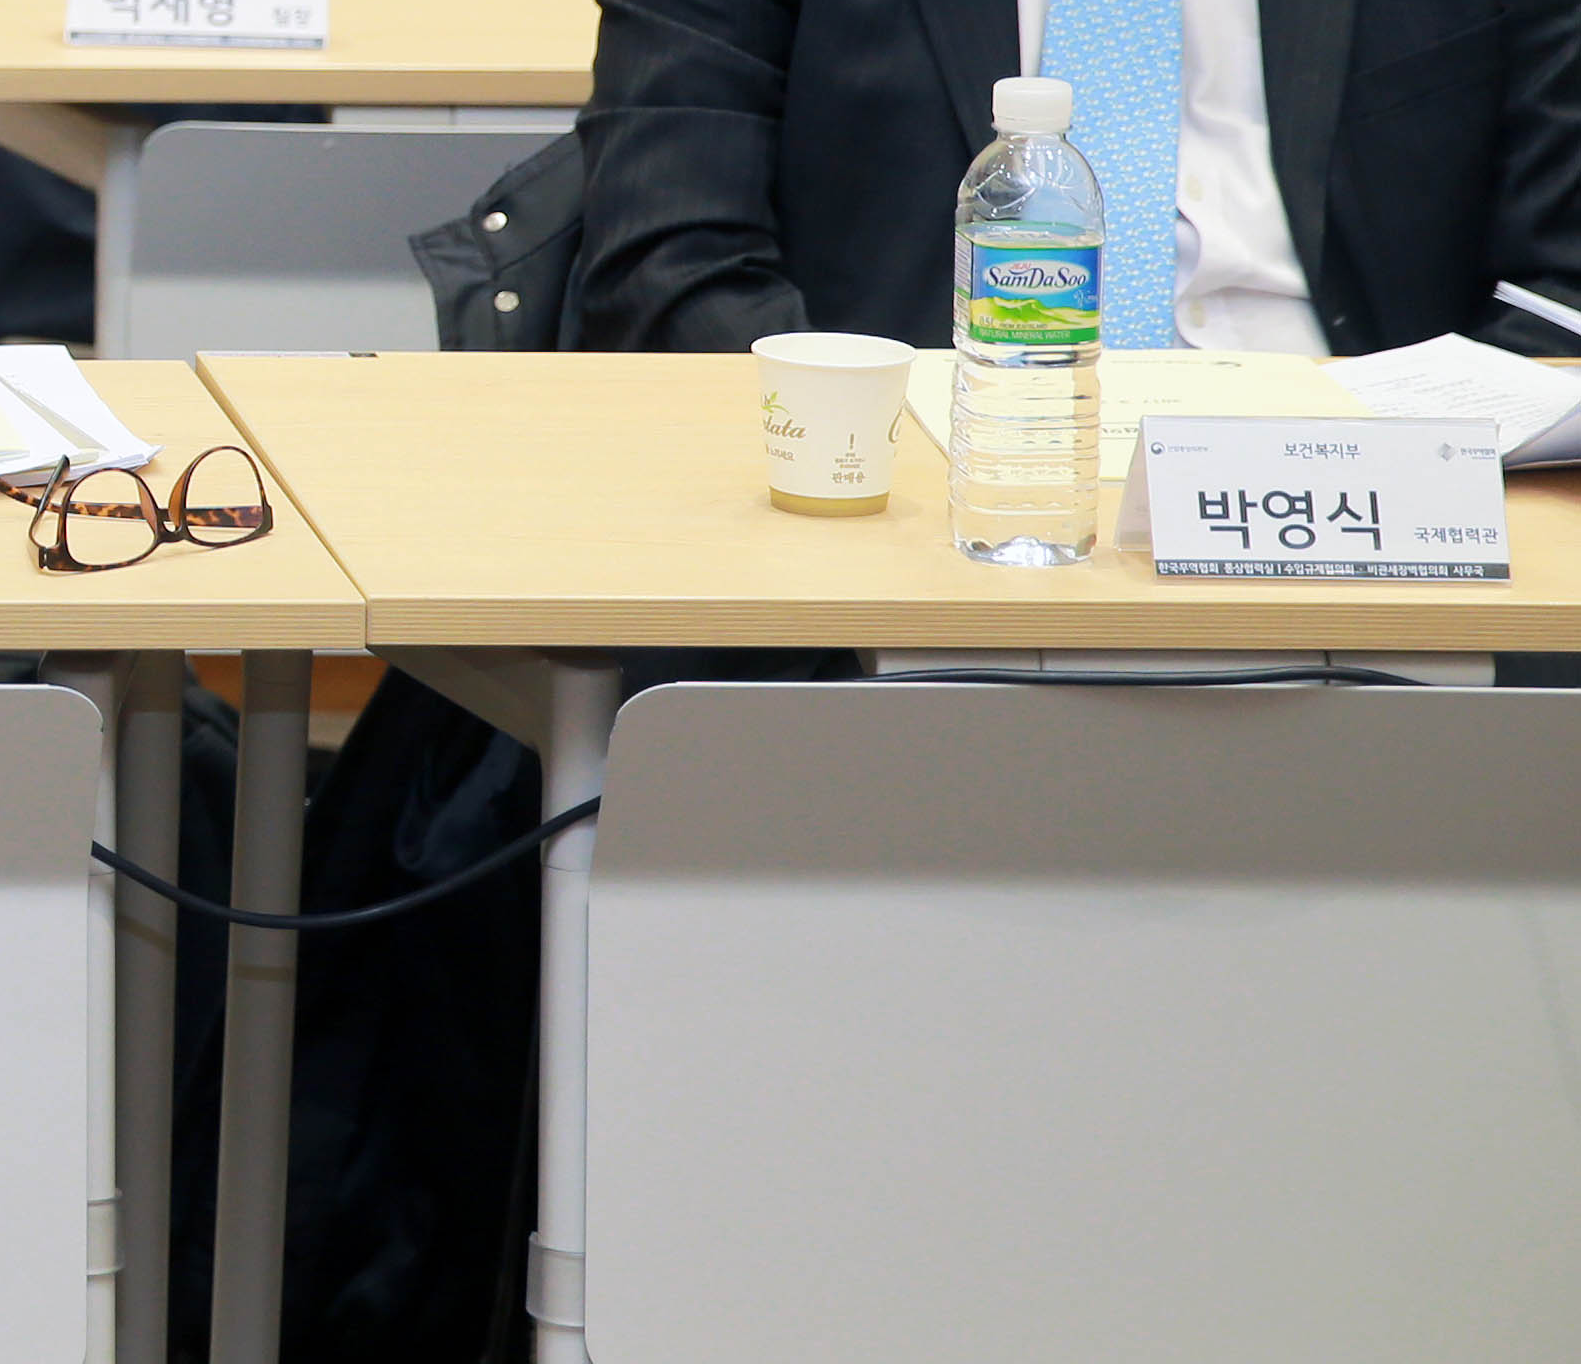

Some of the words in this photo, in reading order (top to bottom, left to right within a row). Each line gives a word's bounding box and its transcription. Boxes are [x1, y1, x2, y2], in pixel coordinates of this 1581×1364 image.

[987, 266, 1086, 289] SamDaSoo
[1284, 442, 1361, 460] 보건복지부
[1196, 488, 1383, 552] 박영식
[1413, 526, 1499, 546] 국제협력관
